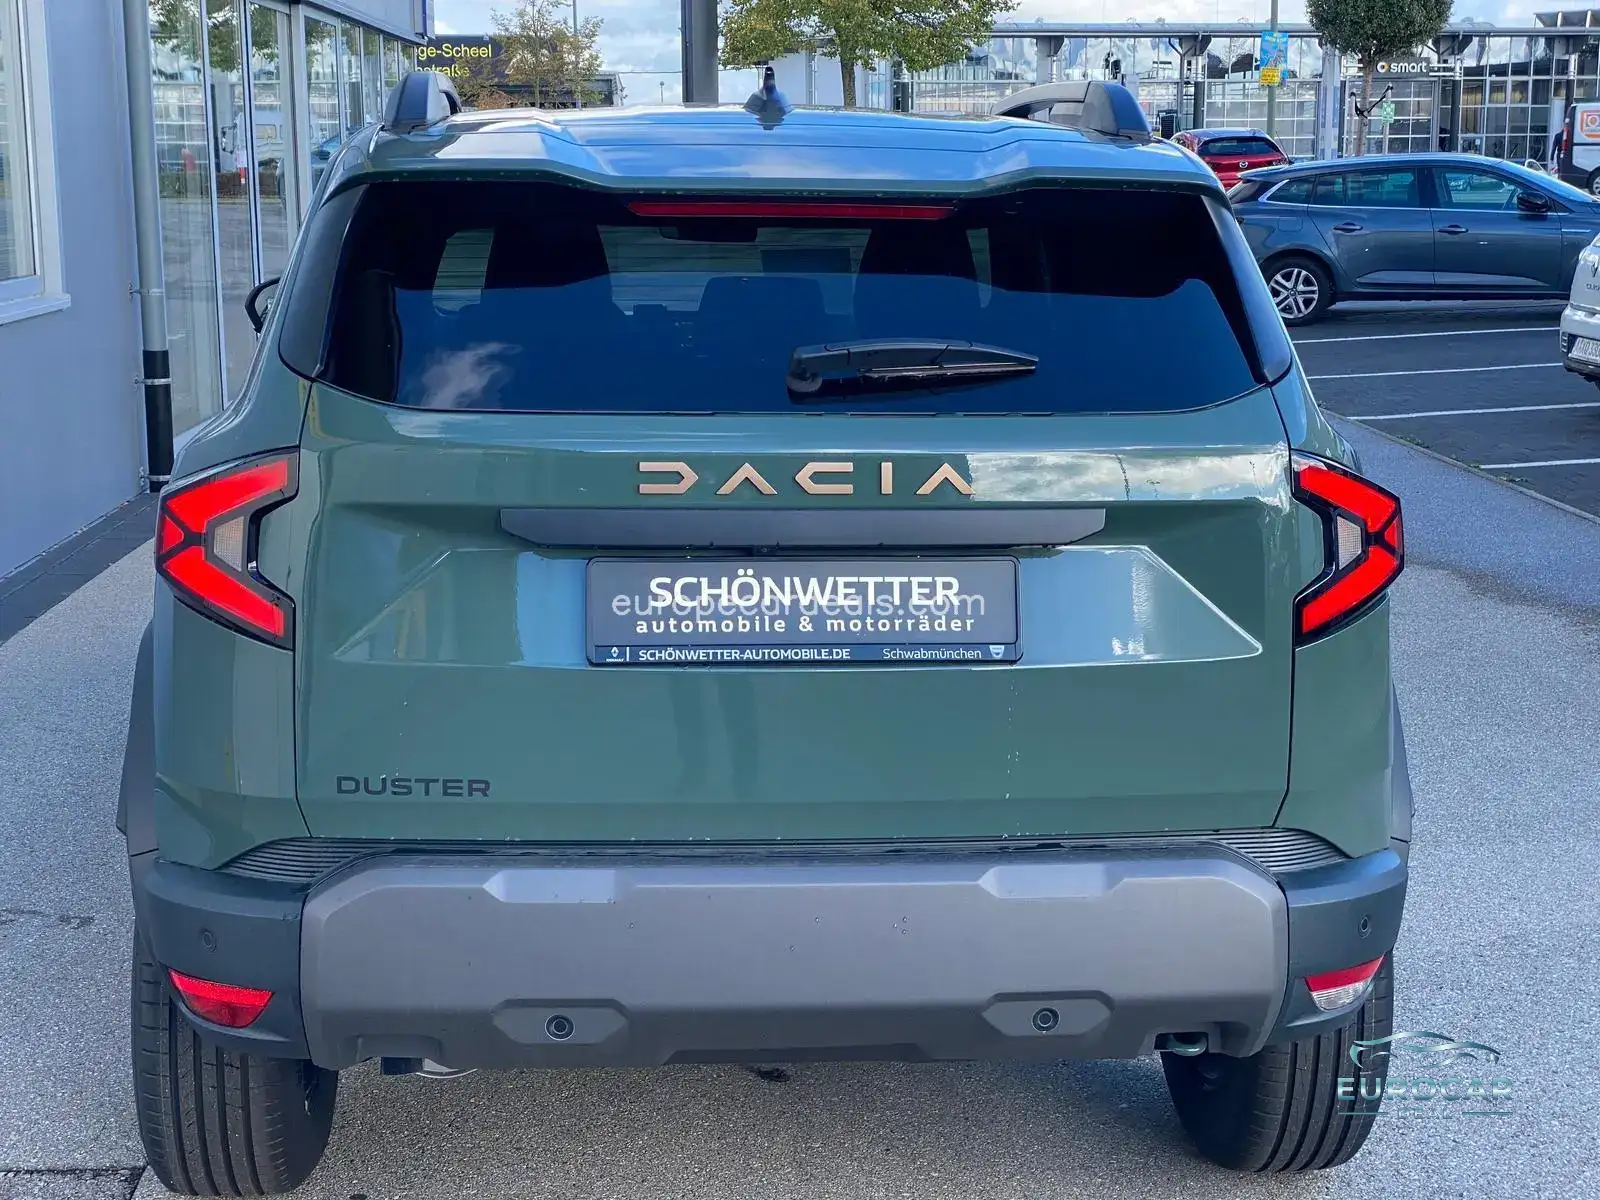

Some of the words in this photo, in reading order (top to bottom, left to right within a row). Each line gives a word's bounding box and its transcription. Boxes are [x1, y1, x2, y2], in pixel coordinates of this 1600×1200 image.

[416, 44, 491, 60] ge-Scheel
[1390, 61, 1427, 72] smart
[639, 461, 976, 495] DACIA
[650, 568, 960, 607] SCHÖNWETTER
[636, 616, 786, 633] automobile
[799, 616, 814, 632] &
[826, 615, 975, 632] motorräder
[638, 647, 851, 661] SCHÖNWETTER-AUTOMOBILE.DE
[882, 648, 982, 660] Schwabmünchen
[336, 776, 491, 797] DUSTER
